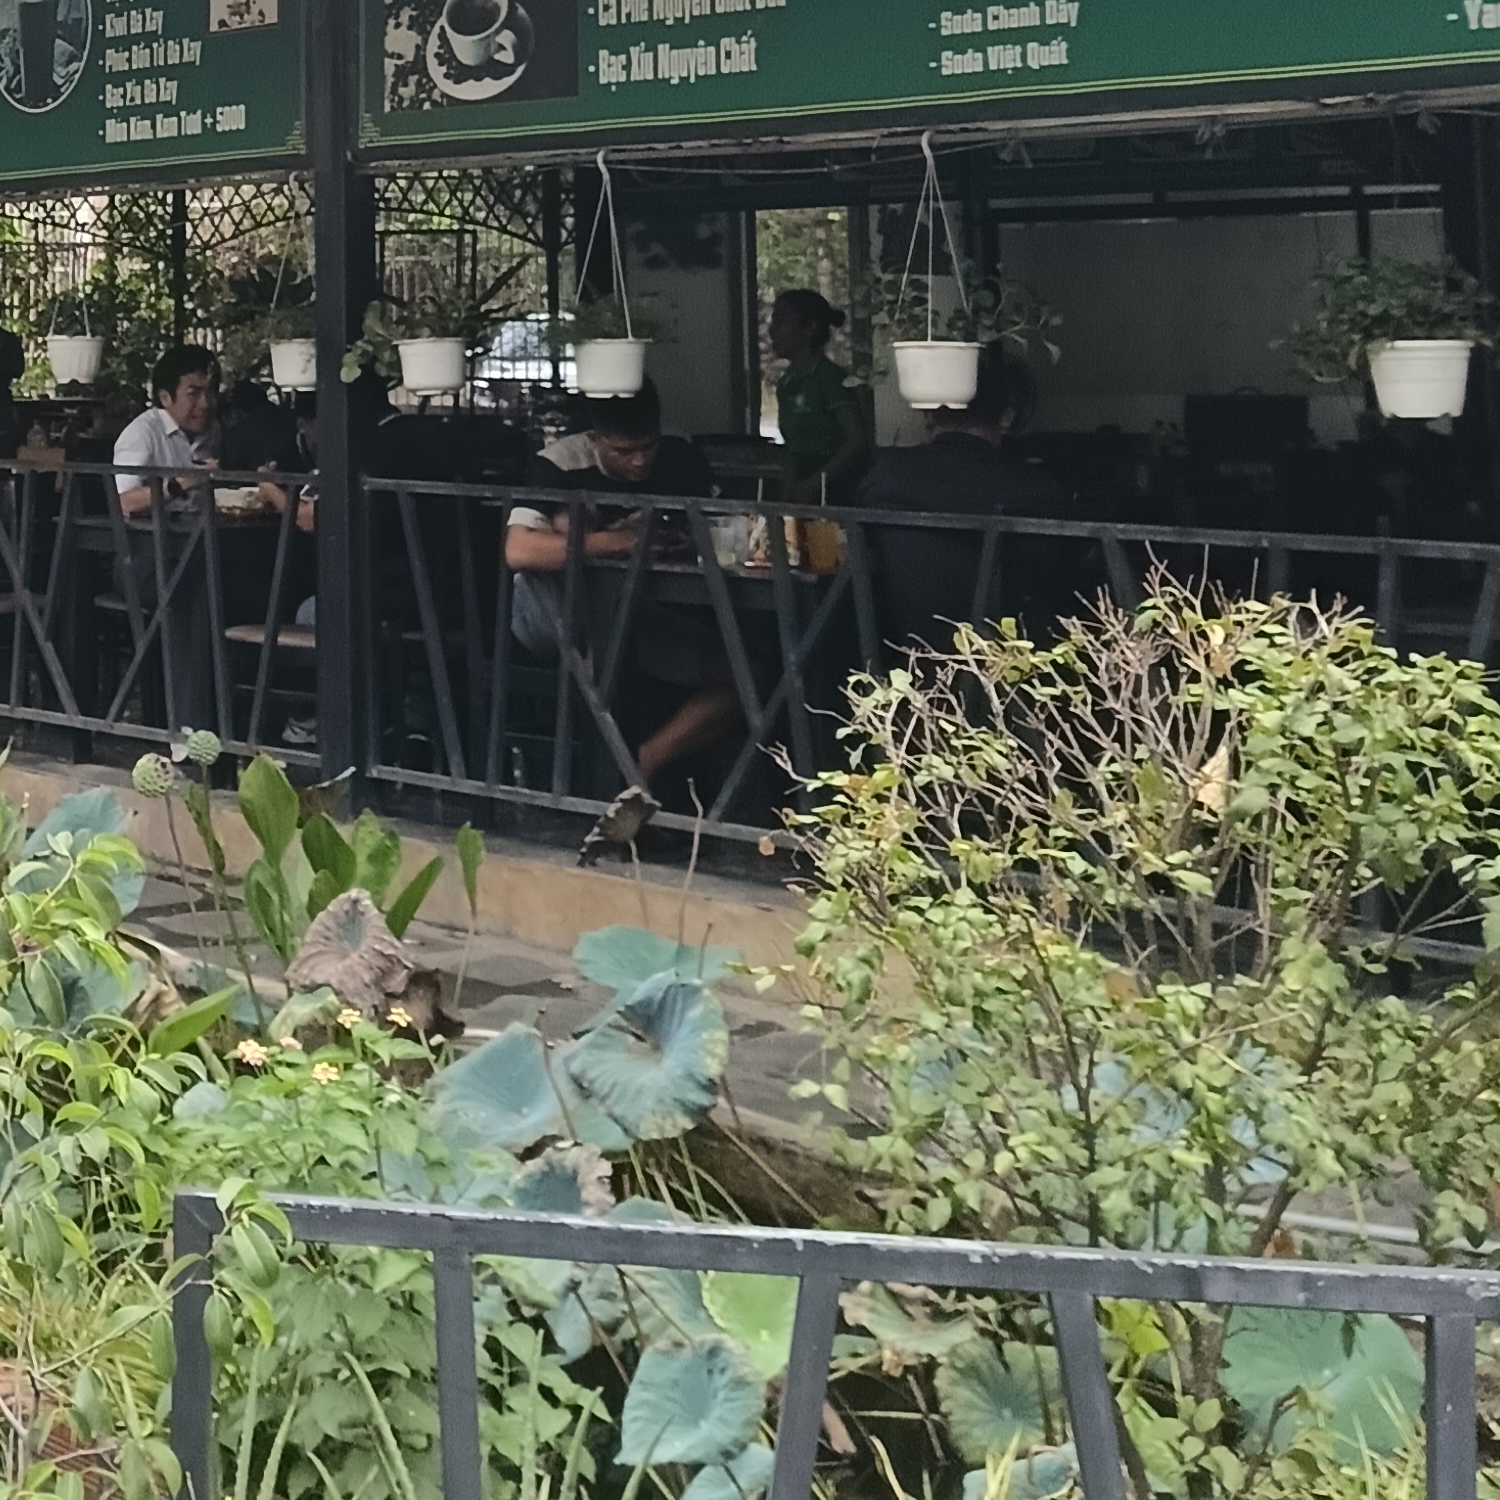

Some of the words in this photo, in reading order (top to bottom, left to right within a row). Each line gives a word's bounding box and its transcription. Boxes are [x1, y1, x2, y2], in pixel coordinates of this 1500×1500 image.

[144, 7, 164, 35] Xay
[940, 9, 983, 36] Soda
[987, 1, 1040, 31] Chanh
[182, 37, 202, 66] Xay
[599, 49, 627, 92] Bạc
[629, 41, 654, 82] Xỉu
[657, 39, 716, 85] Nguyên
[720, 30, 757, 73] Chất
[941, 48, 984, 76] Soda
[987, 44, 1022, 74] Việt
[1027, 36, 1069, 70] Quất
[158, 77, 178, 106] Xay
